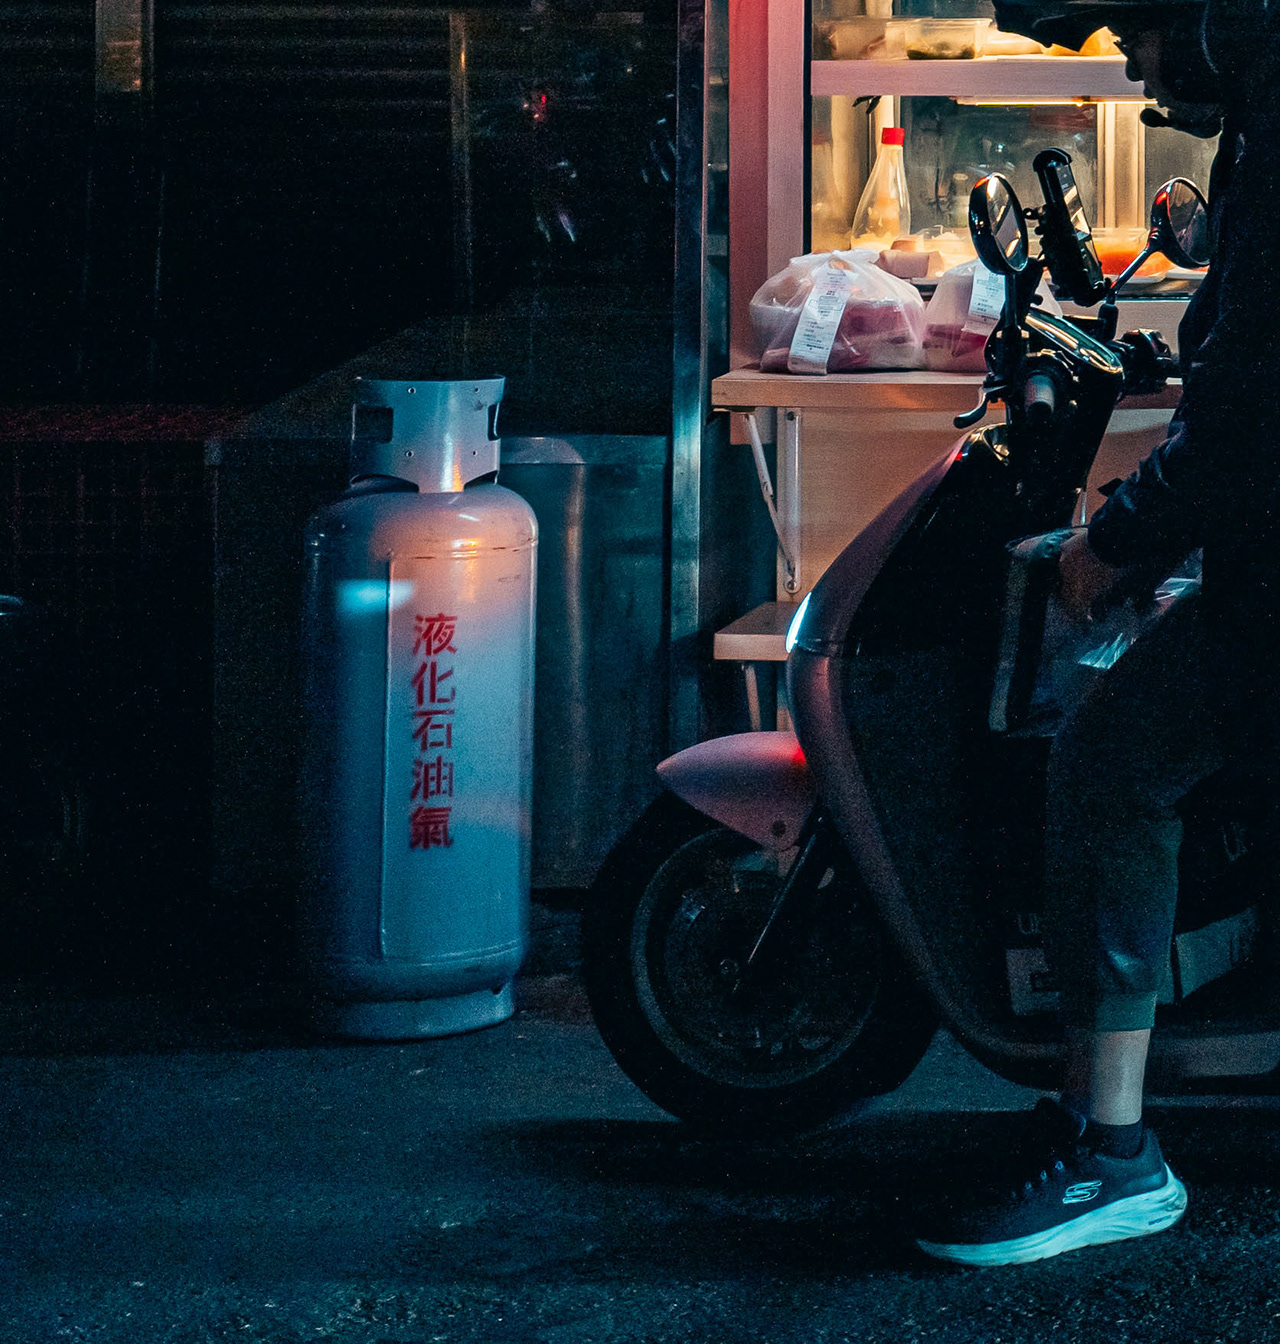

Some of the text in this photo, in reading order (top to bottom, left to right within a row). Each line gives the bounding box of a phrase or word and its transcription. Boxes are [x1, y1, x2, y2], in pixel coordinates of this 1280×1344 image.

[409, 613, 458, 850] 液化石油氣
